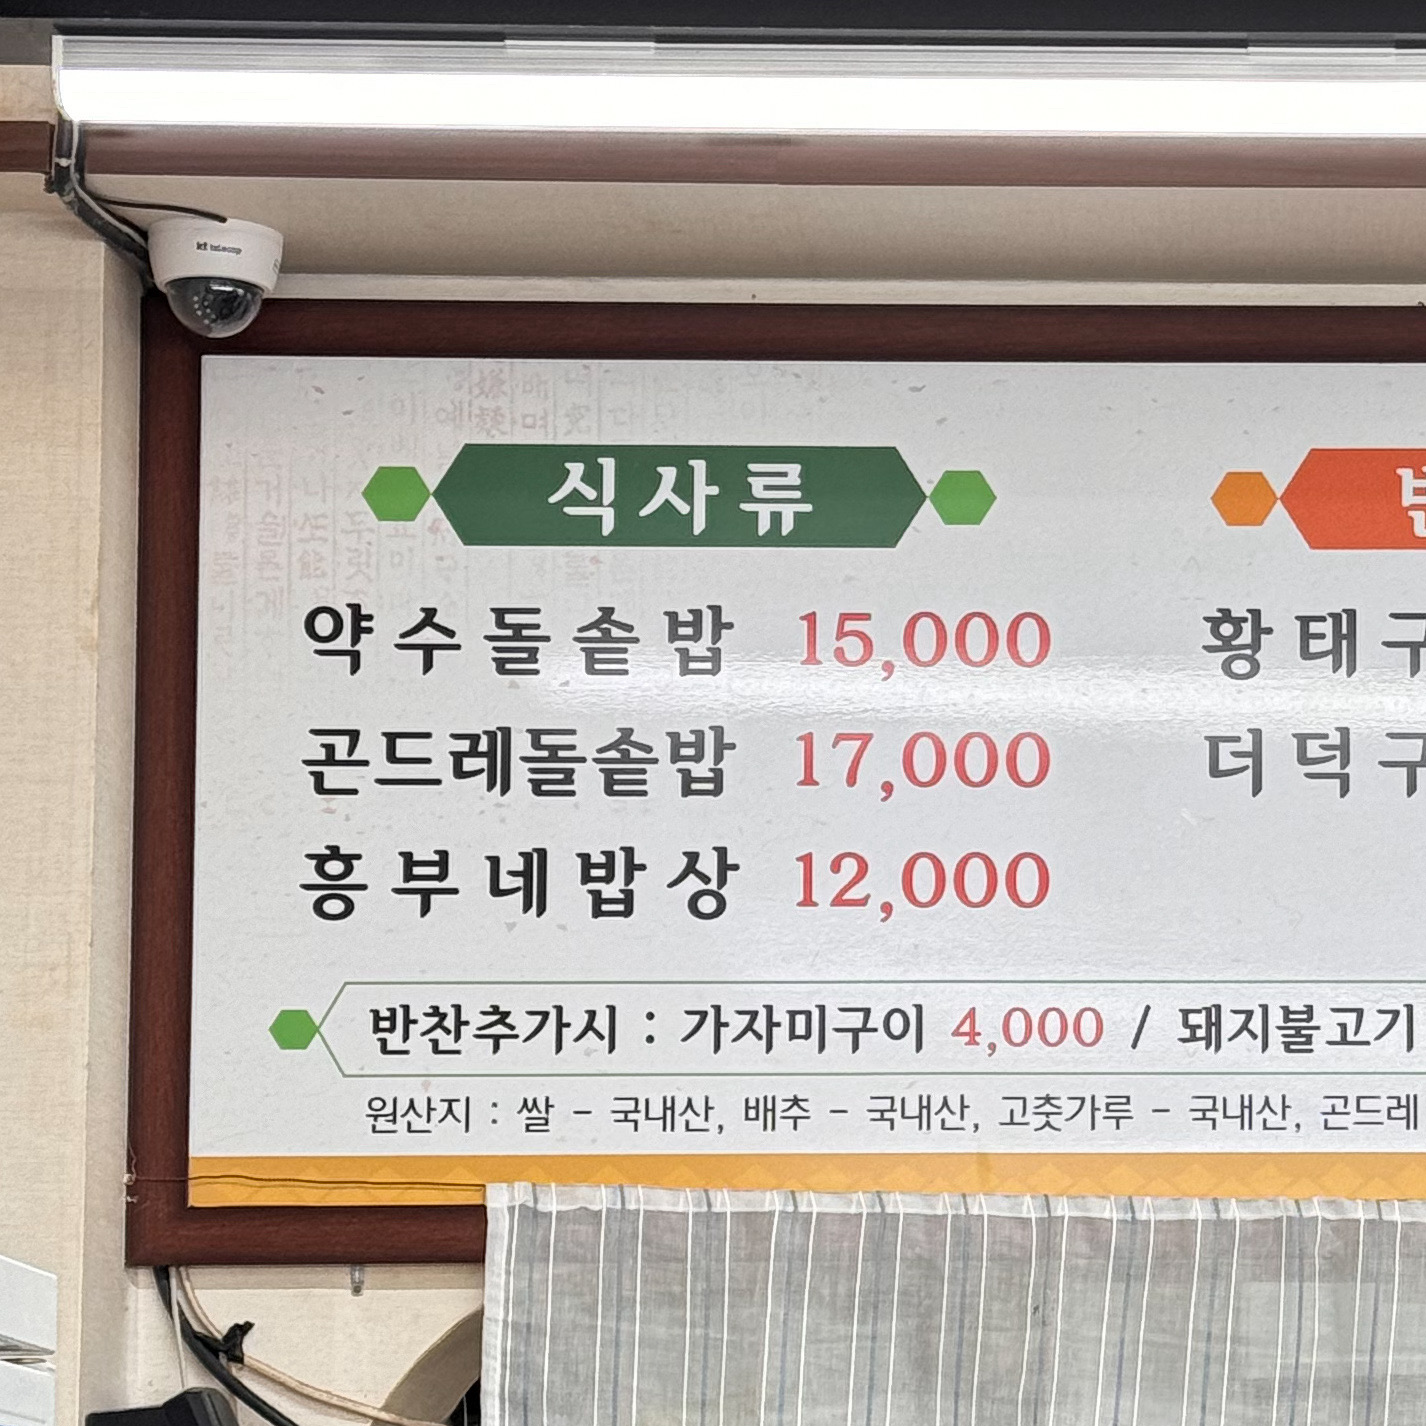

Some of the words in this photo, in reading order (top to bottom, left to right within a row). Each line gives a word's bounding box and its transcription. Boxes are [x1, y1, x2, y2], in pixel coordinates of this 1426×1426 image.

[546, 456, 814, 538] 식사류
[304, 603, 734, 675] 약수돌솥밥
[799, 611, 1052, 678] 15,000
[302, 726, 736, 797] 곤드레돌솥밥
[795, 731, 1052, 802] 17,000
[300, 845, 740, 921] 흥부네밥상
[795, 850, 1051, 923] 12,000
[370, 1004, 616, 1055] 반찬추가시
[681, 1004, 922, 1054] 가자미구이
[951, 1006, 1104, 1057] 4,000
[1178, 1004, 1413, 1053] 돼지불고기
[366, 1096, 469, 1133] 원산지
[517, 1096, 554, 1132] 쌀
[612, 1096, 723, 1134] 국내산,
[745, 1095, 810, 1131] 배추
[867, 1094, 978, 1133] 국내산,
[1000, 1094, 1133, 1131] 고춧가루
[1190, 1094, 1300, 1132] 국내산,
[1321, 1094, 1417, 1130] 곤드레
